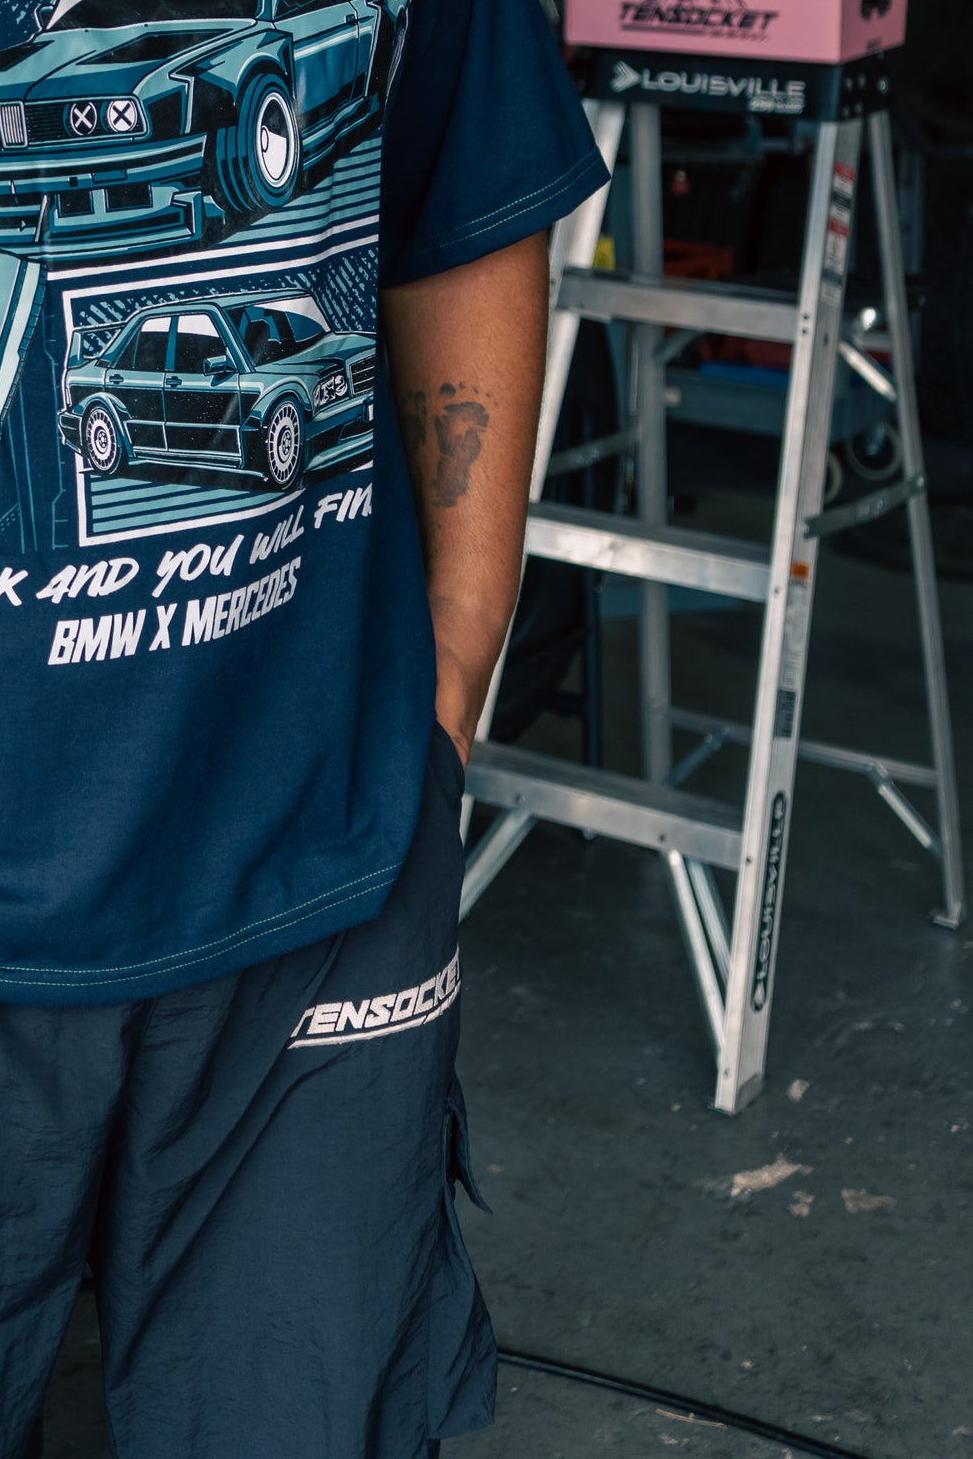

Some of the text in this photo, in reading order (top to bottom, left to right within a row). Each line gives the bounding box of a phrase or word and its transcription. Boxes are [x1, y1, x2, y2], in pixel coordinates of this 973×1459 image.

[619, 1, 780, 30] TENSOCKET
[640, 68, 806, 97] LOUISVILLE
[36, 557, 139, 604] AND
[152, 534, 244, 597] YOU
[249, 504, 305, 565] WILL
[314, 482, 373, 529] FIN
[48, 556, 301, 665] BMW X MERCEDES
